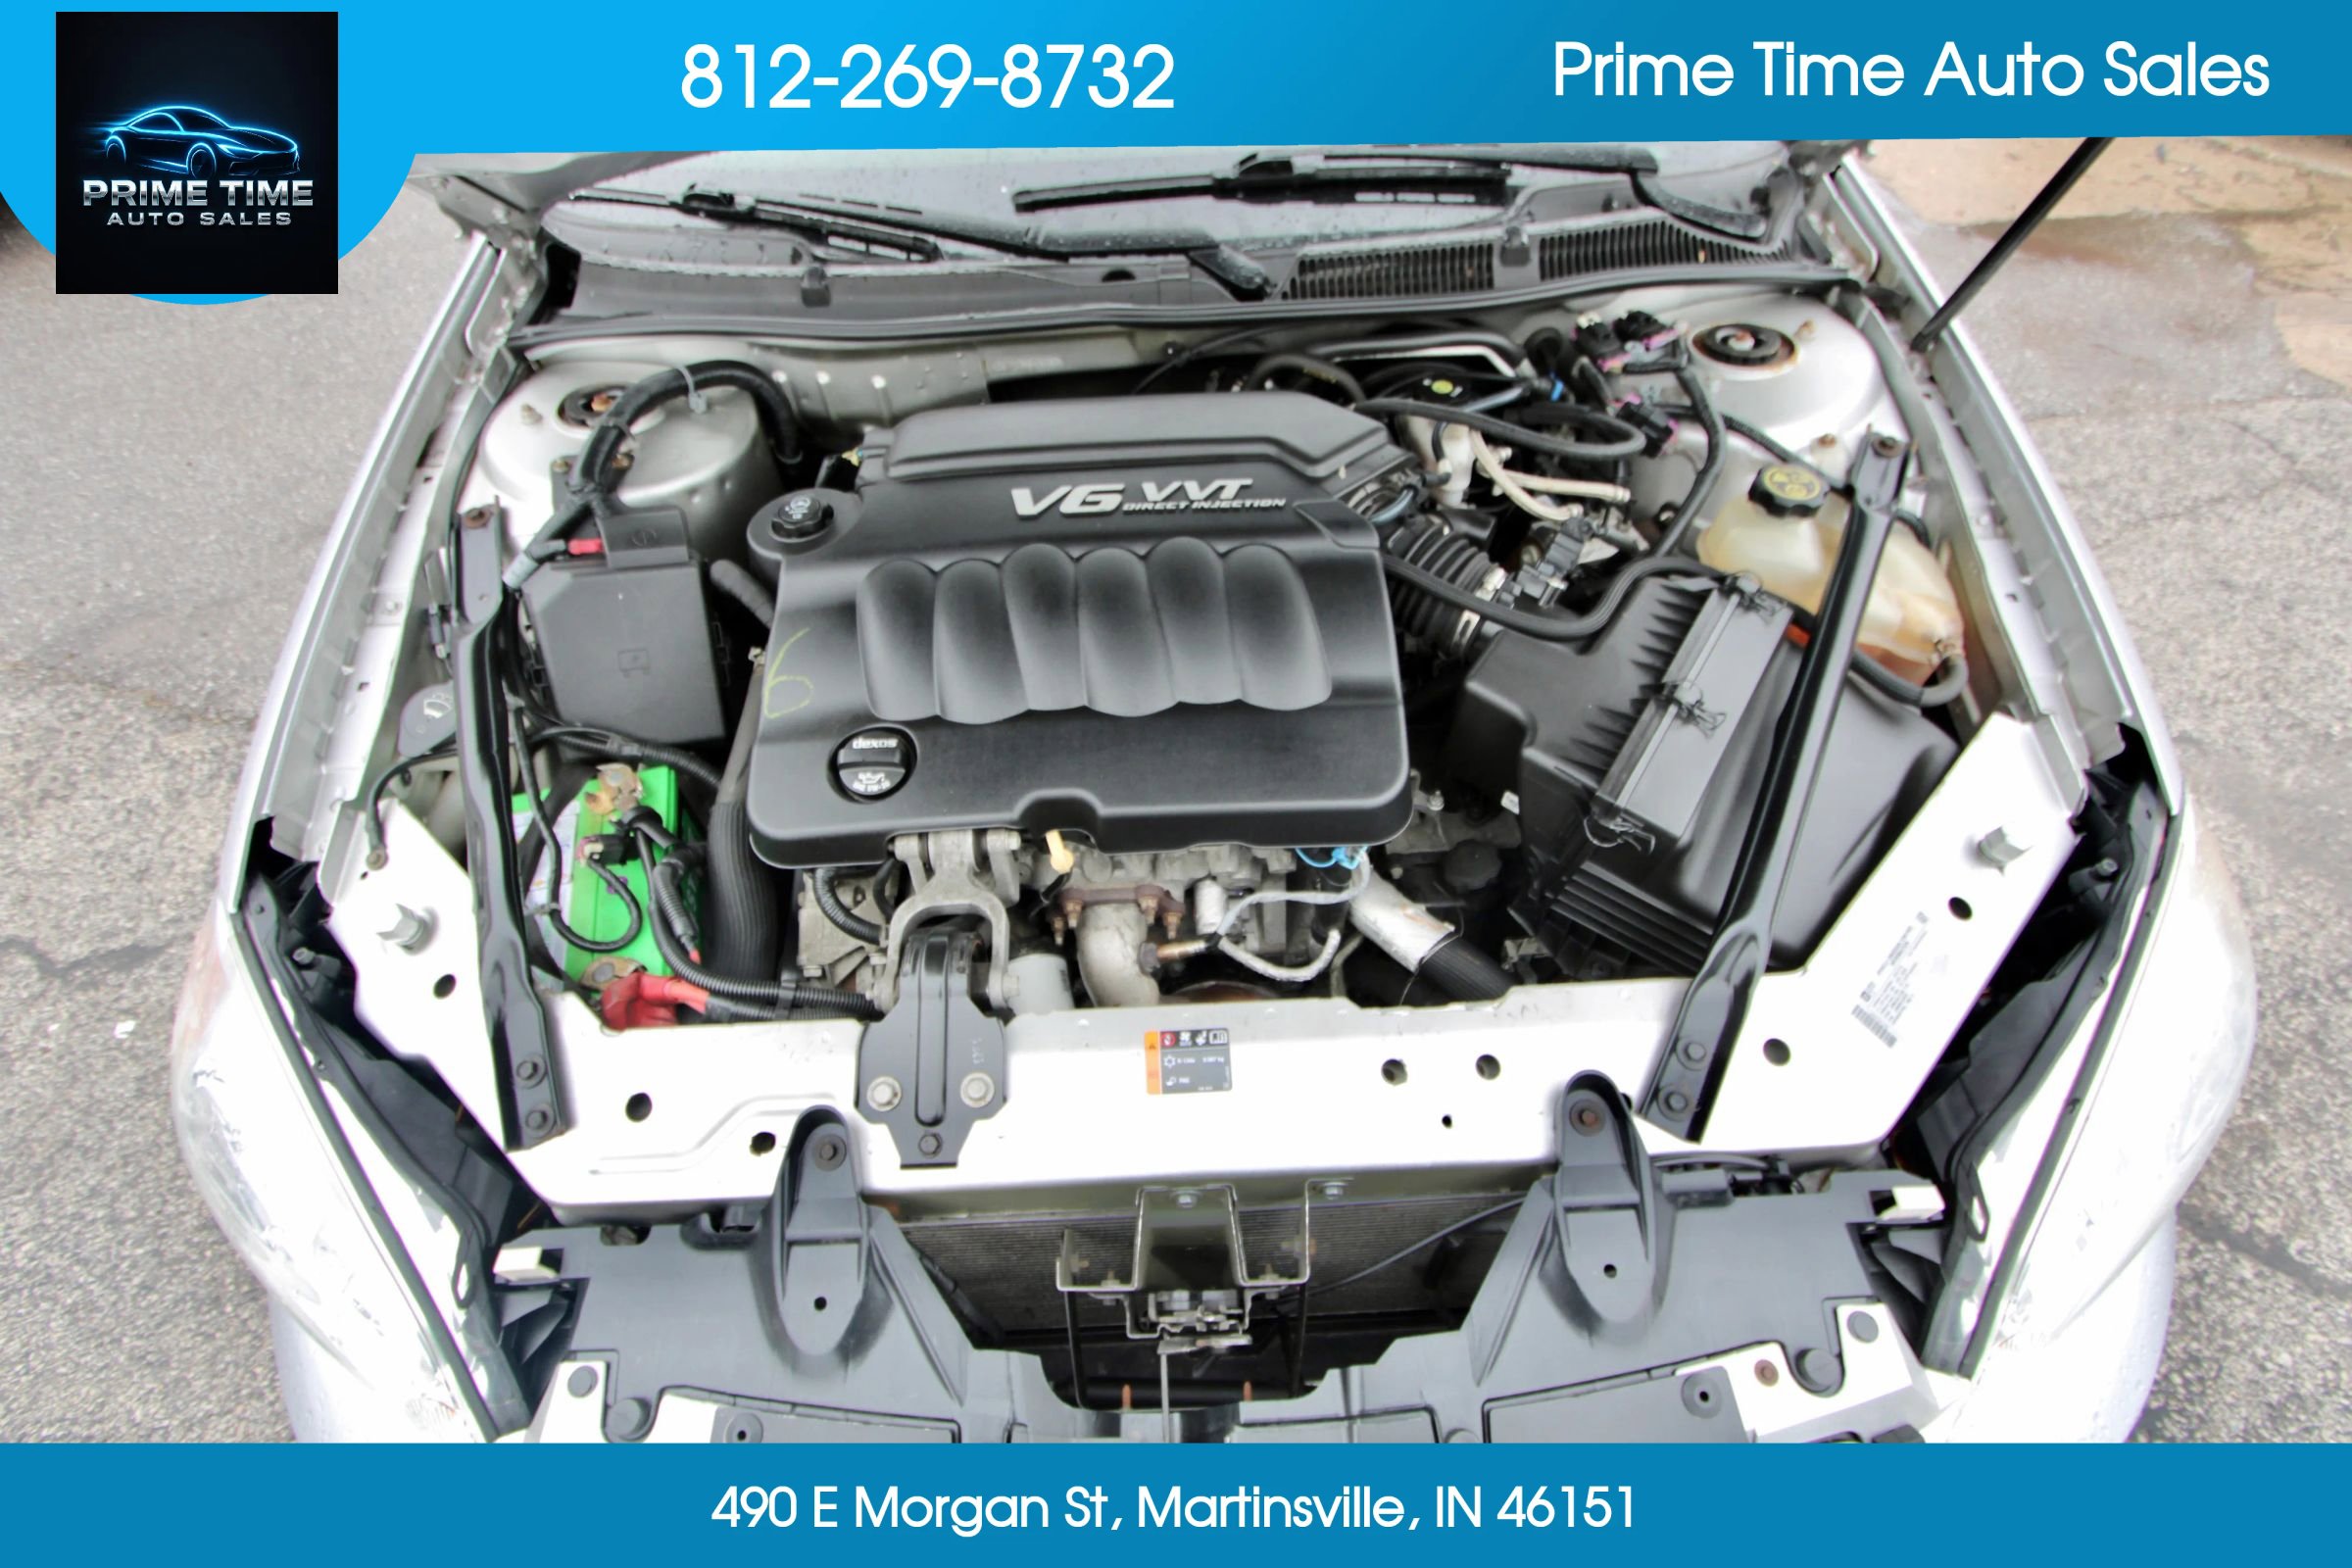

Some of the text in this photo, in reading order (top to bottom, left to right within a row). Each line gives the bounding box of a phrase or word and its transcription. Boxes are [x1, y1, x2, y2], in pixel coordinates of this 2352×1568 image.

[1010, 477, 1253, 515] V6 VVT
[1122, 497, 1287, 512] DIRECT INJECTION
[764, 626, 814, 718] 6
[852, 736, 899, 750] dexos
